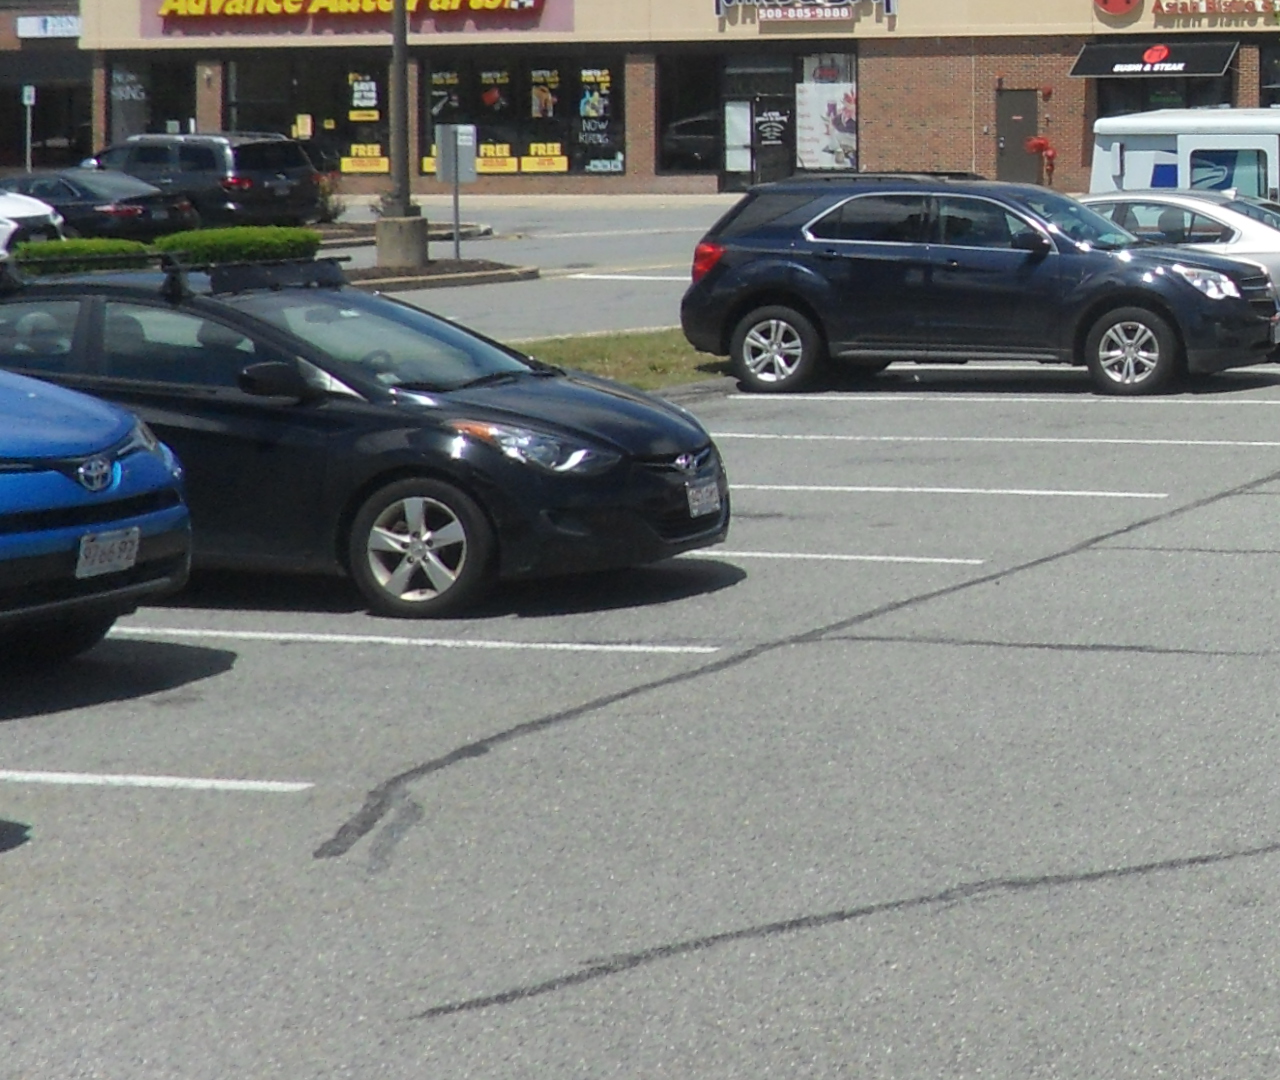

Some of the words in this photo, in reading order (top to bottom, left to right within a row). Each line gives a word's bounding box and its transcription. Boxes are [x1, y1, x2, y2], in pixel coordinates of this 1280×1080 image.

[1113, 63, 1143, 72] SUSHI
[1143, 64, 1152, 72] &
[1152, 62, 1186, 72] STEAK
[582, 119, 610, 132] NOW
[350, 143, 382, 157] FREE
[479, 143, 511, 157] FREE
[529, 142, 562, 156] FREE
